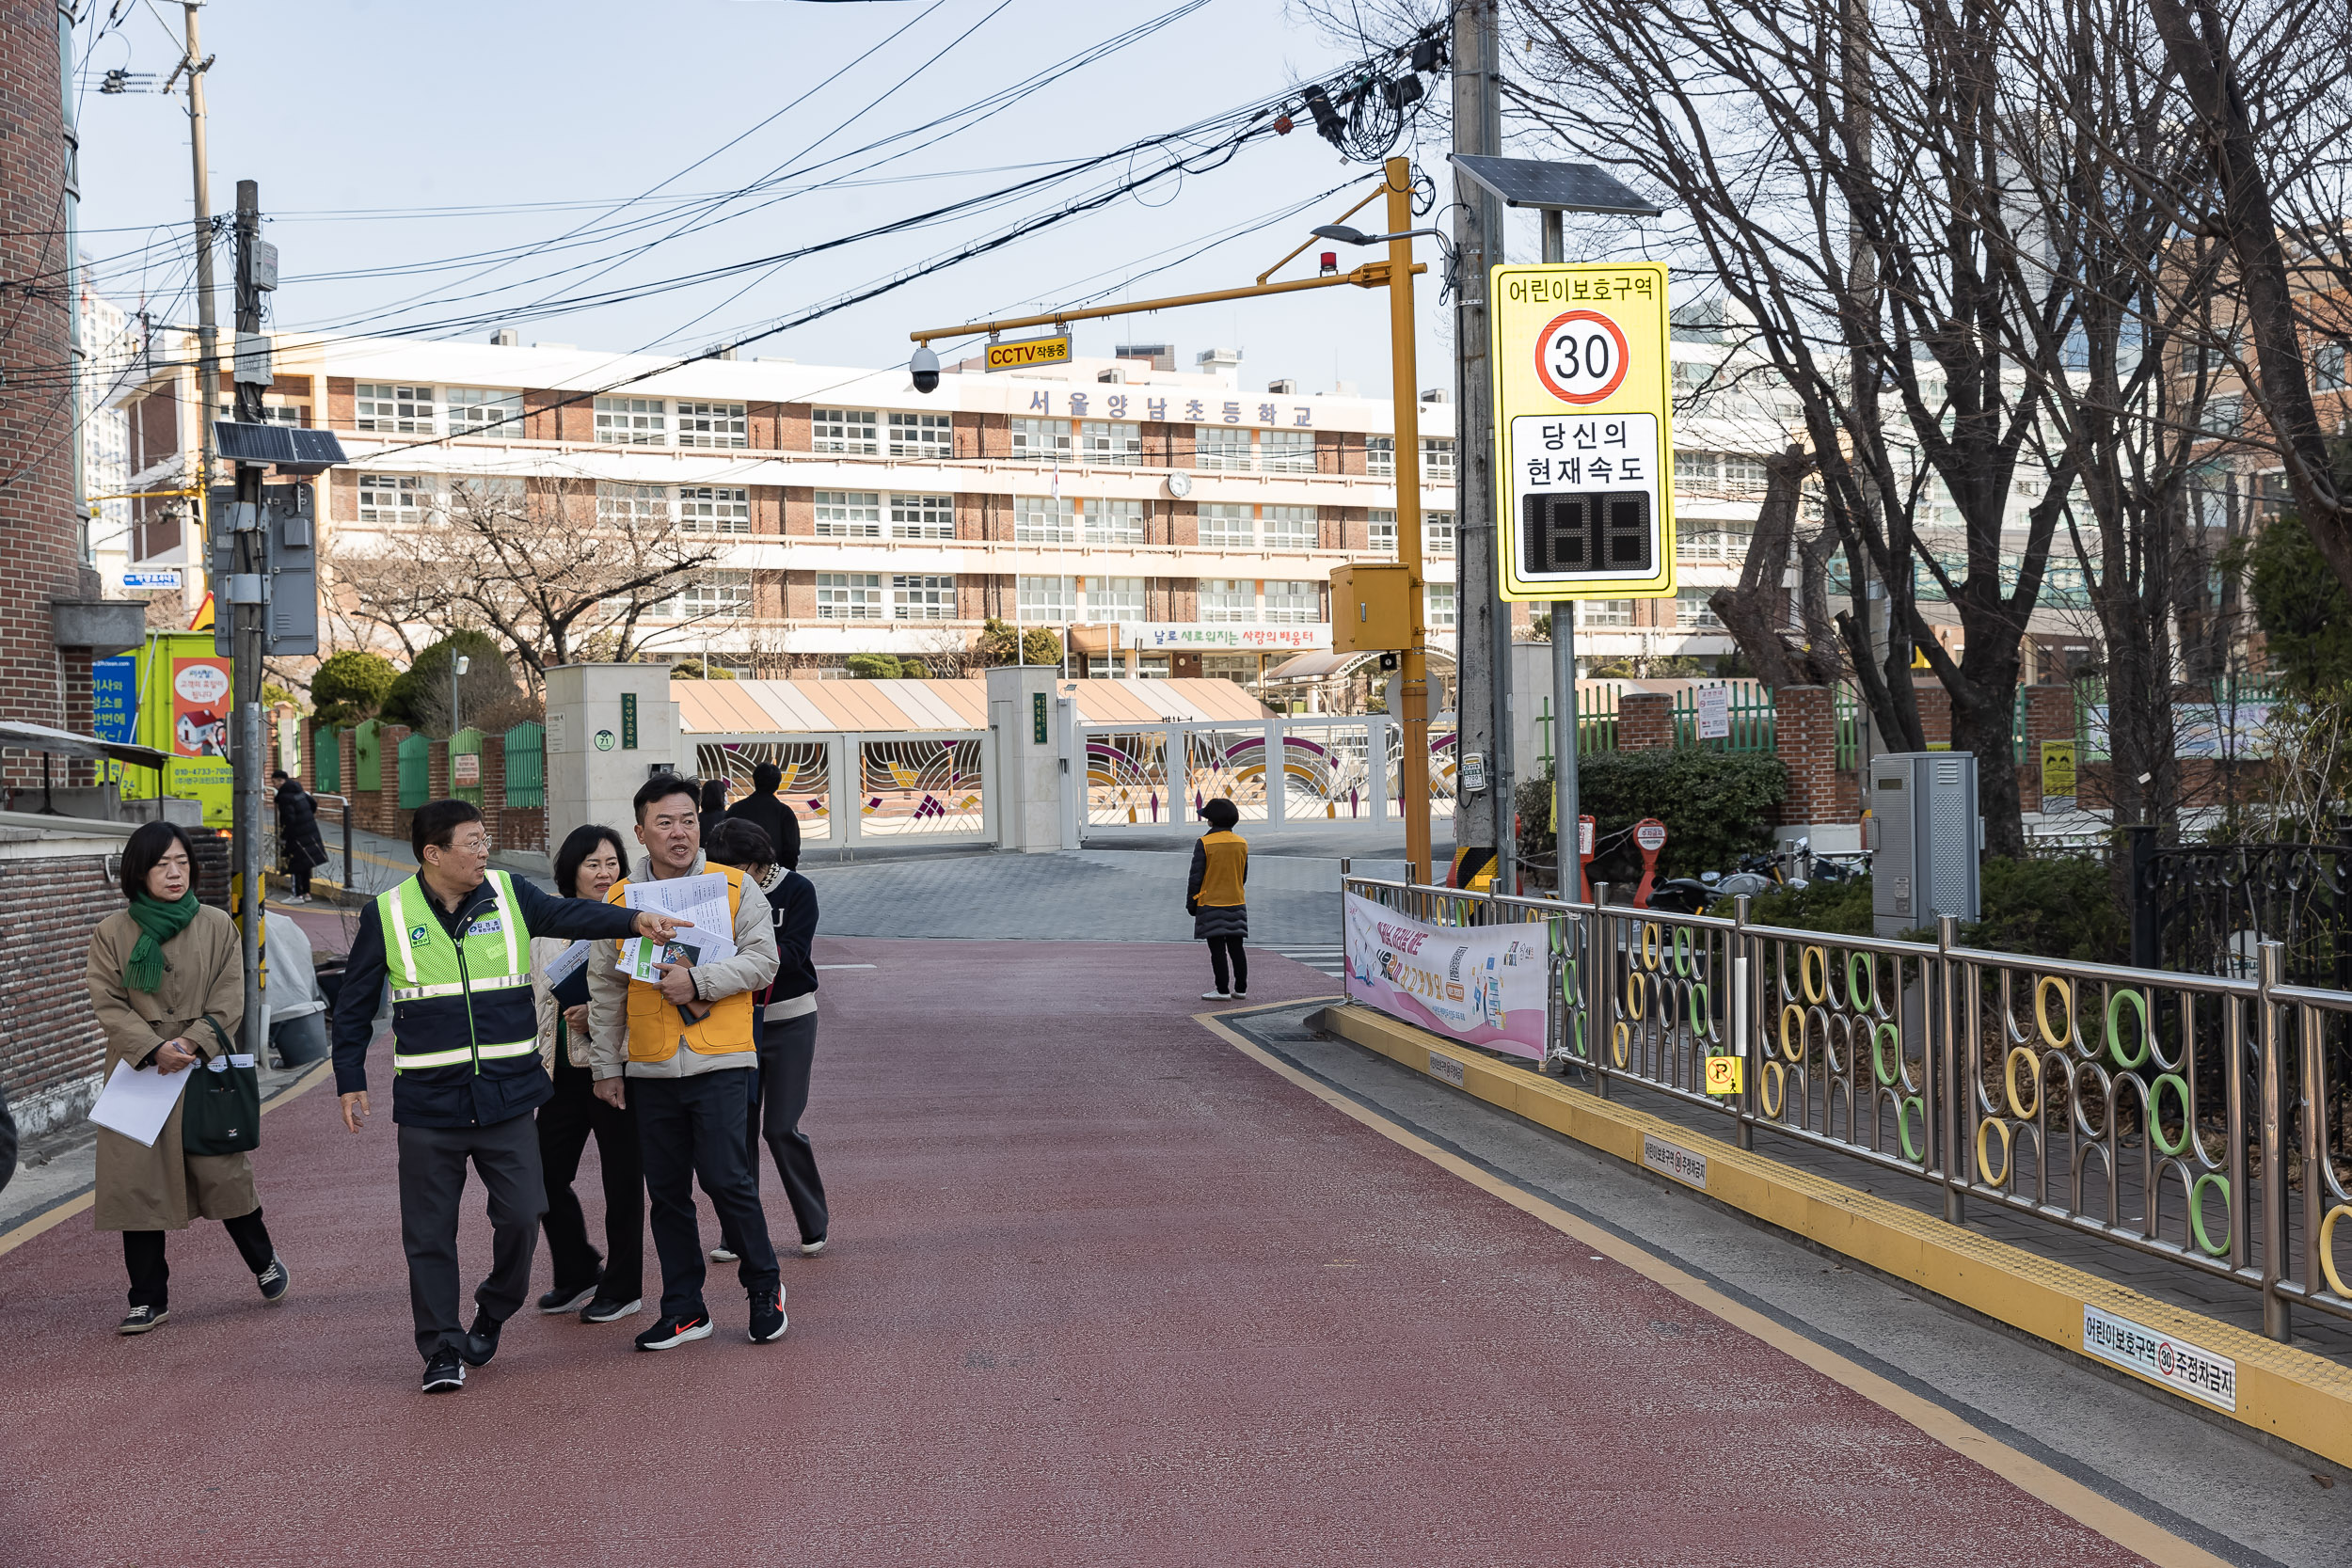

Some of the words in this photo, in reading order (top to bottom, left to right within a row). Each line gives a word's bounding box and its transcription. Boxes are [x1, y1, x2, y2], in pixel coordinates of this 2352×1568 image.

[1509, 276, 1653, 303] 어린이보호구역
[1555, 334, 1609, 379] 30
[1029, 391, 1312, 427] 서울양남초등학교
[1542, 420, 1627, 450] 당신의
[1527, 456, 1645, 486] 현재속도
[1154, 630, 1178, 645] 날로
[1182, 630, 1239, 646] 새로워지는
[1243, 631, 1277, 645] 사랑의
[1279, 631, 1313, 646] 배움터
[1645, 1141, 1675, 1169] 어린이보호구역
[1682, 1156, 1706, 1181] 주정차금지
[2086, 1316, 2155, 1368] 어린이보호구역
[2161, 1349, 2173, 1369] 30
[2176, 1351, 2233, 1400] 주정차금지
